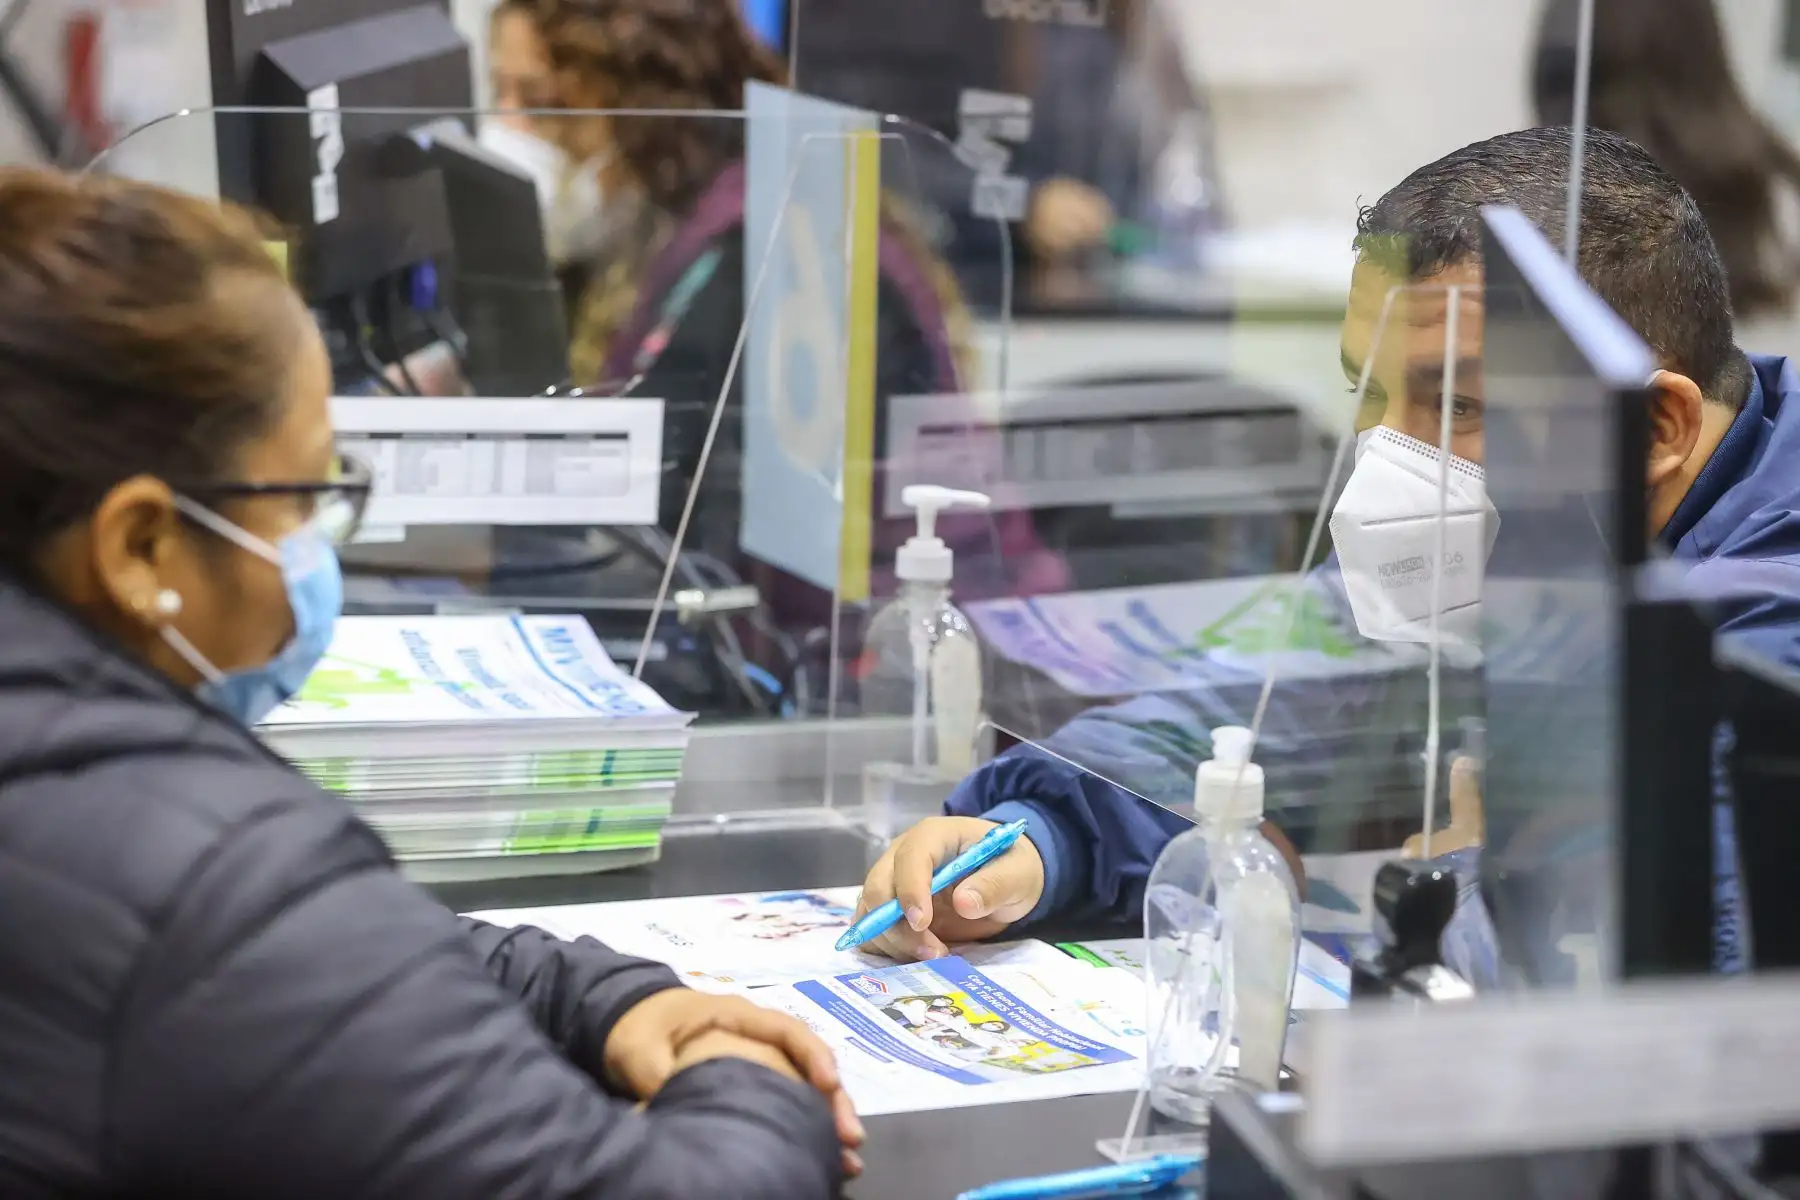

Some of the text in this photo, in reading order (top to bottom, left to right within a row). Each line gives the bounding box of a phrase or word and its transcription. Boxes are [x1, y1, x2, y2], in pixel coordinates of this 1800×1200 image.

[967, 974, 985, 987] Con
[992, 989, 1016, 1007] Bono
[1014, 1006, 1052, 1030] Familiar
[977, 991, 1010, 1011] TIENES
[1007, 1012, 1049, 1038] VIVIENDA
